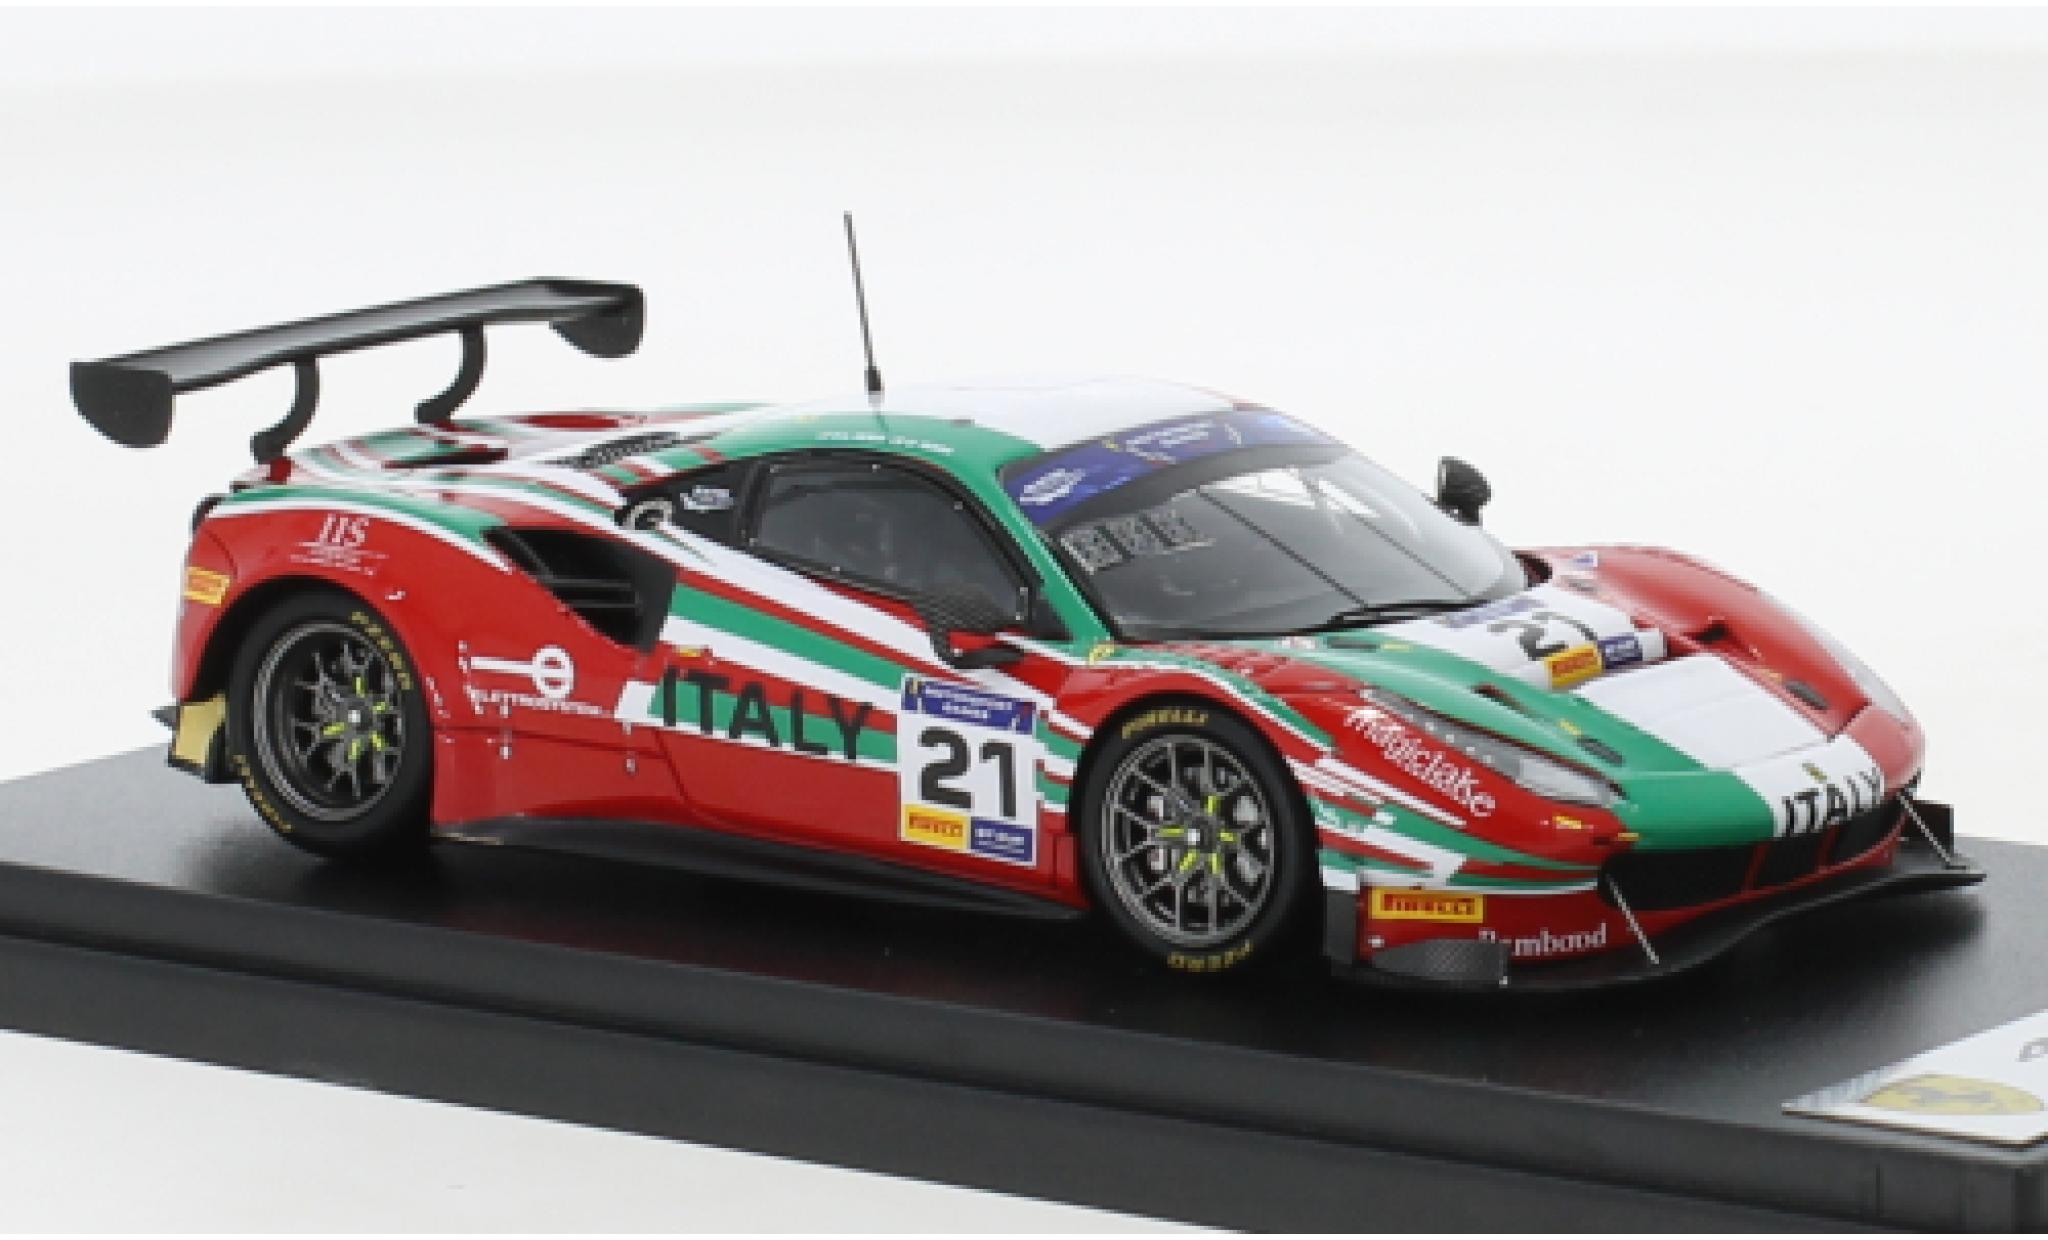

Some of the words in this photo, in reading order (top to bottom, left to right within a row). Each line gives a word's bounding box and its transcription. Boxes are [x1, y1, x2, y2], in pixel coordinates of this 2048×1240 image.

[661, 667, 873, 761] ITALY
[918, 726, 1018, 818] 21
[1781, 767, 1881, 837] ITALY
